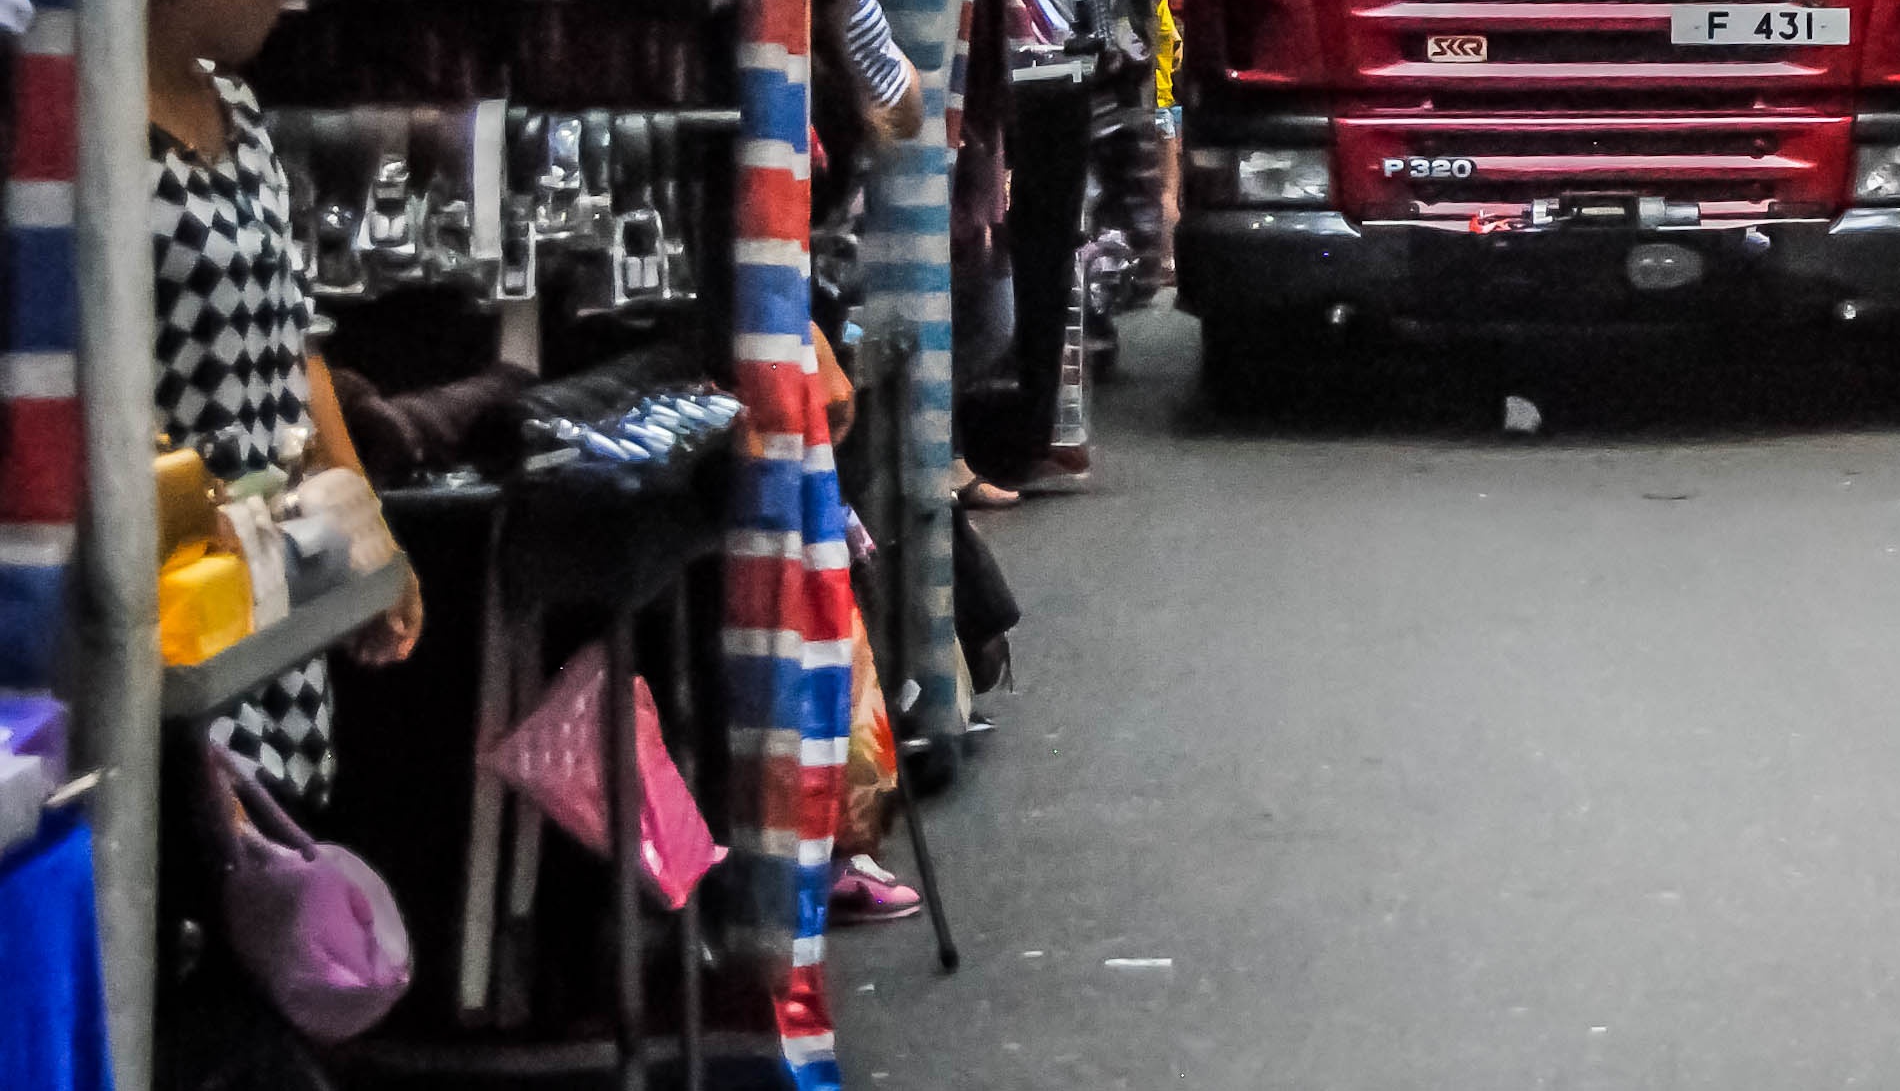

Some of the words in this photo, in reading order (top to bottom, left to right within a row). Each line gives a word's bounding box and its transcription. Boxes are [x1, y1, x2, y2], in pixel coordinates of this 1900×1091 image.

[1707, 12, 1729, 40] F
[1753, 12, 1813, 40] 431
[1384, 158, 1404, 177] P
[1410, 158, 1472, 178] 320
